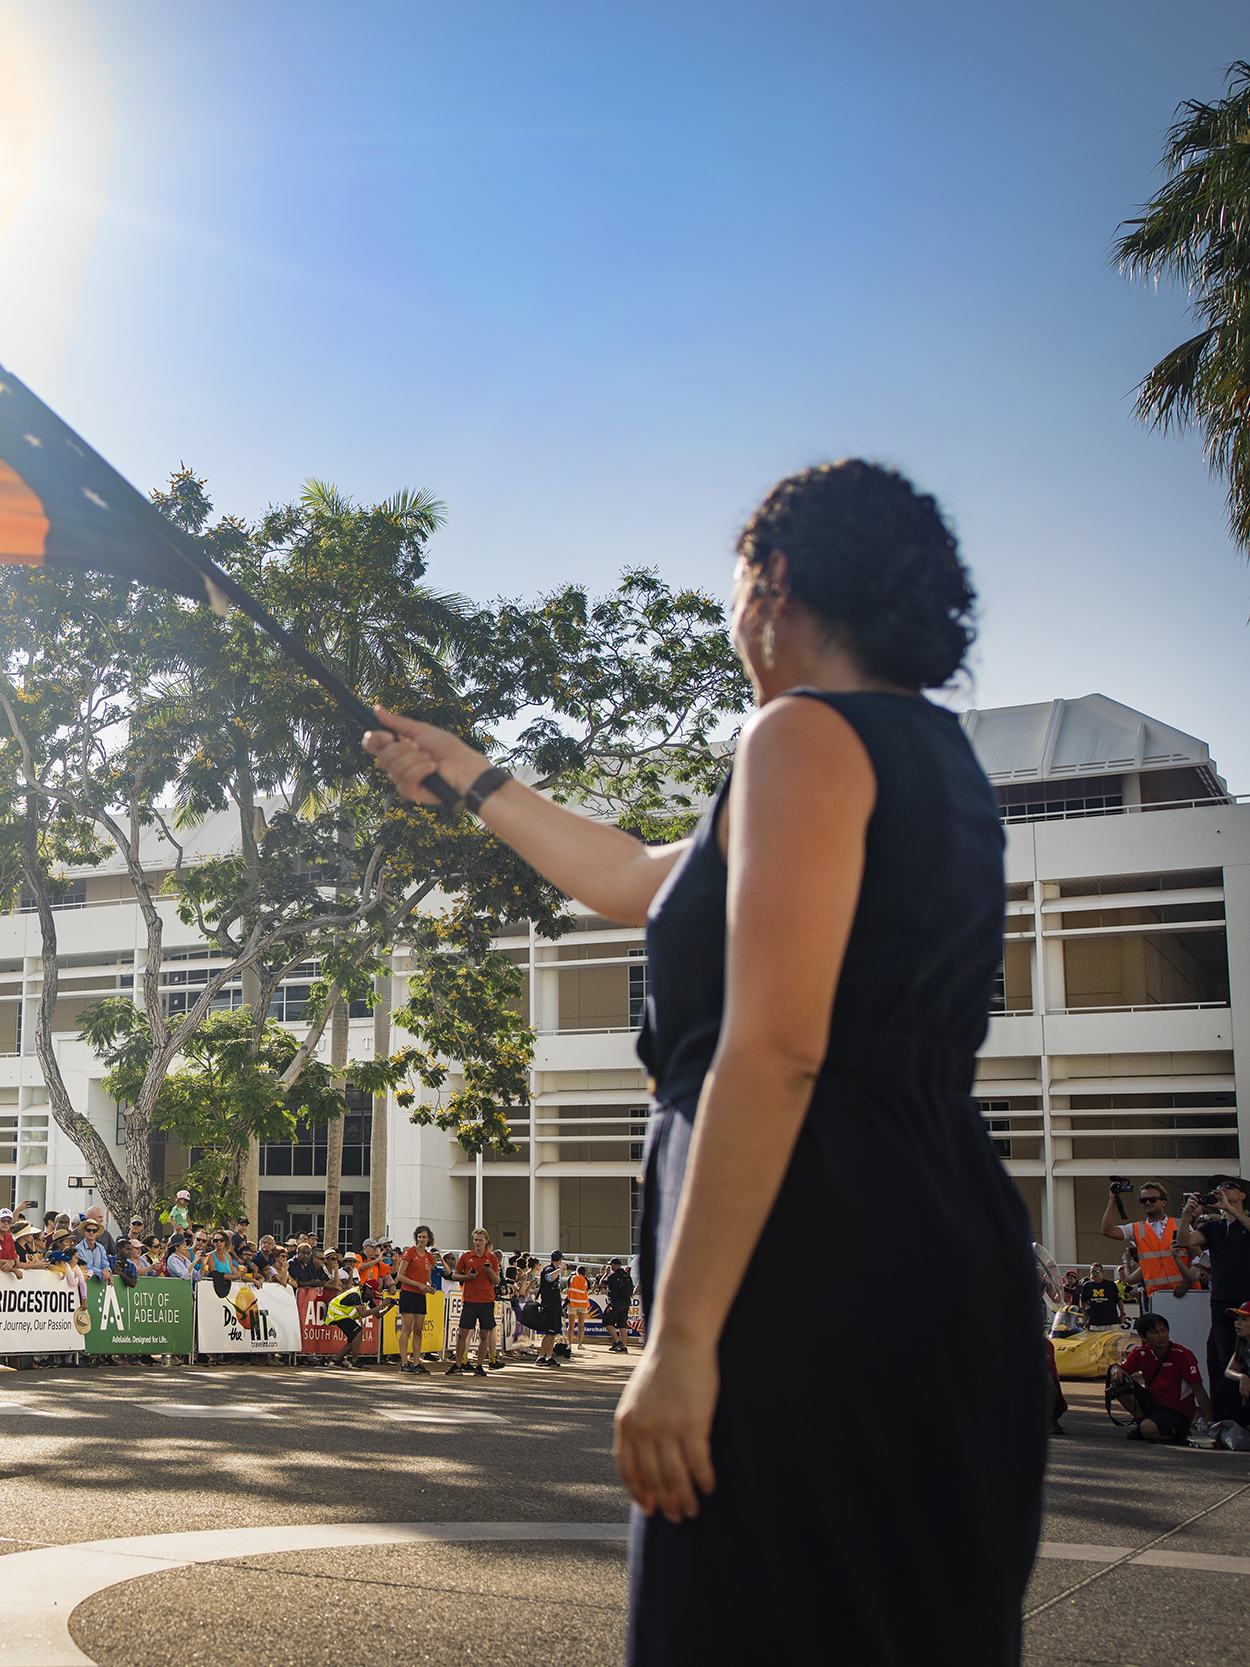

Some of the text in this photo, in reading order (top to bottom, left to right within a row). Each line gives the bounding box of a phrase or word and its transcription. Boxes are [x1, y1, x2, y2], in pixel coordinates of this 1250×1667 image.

[133, 1291, 170, 1307] CITY OF
[134, 1308, 180, 1324] ADELAIDE
[222, 1305, 238, 1327] Do
[3, 1319, 33, 1333] Journey,
[33, 1319, 47, 1331] Our
[48, 1318, 72, 1330] Passion
[228, 1328, 243, 1341] the
[304, 1328, 373, 1342] SOUTH AUSLIA
